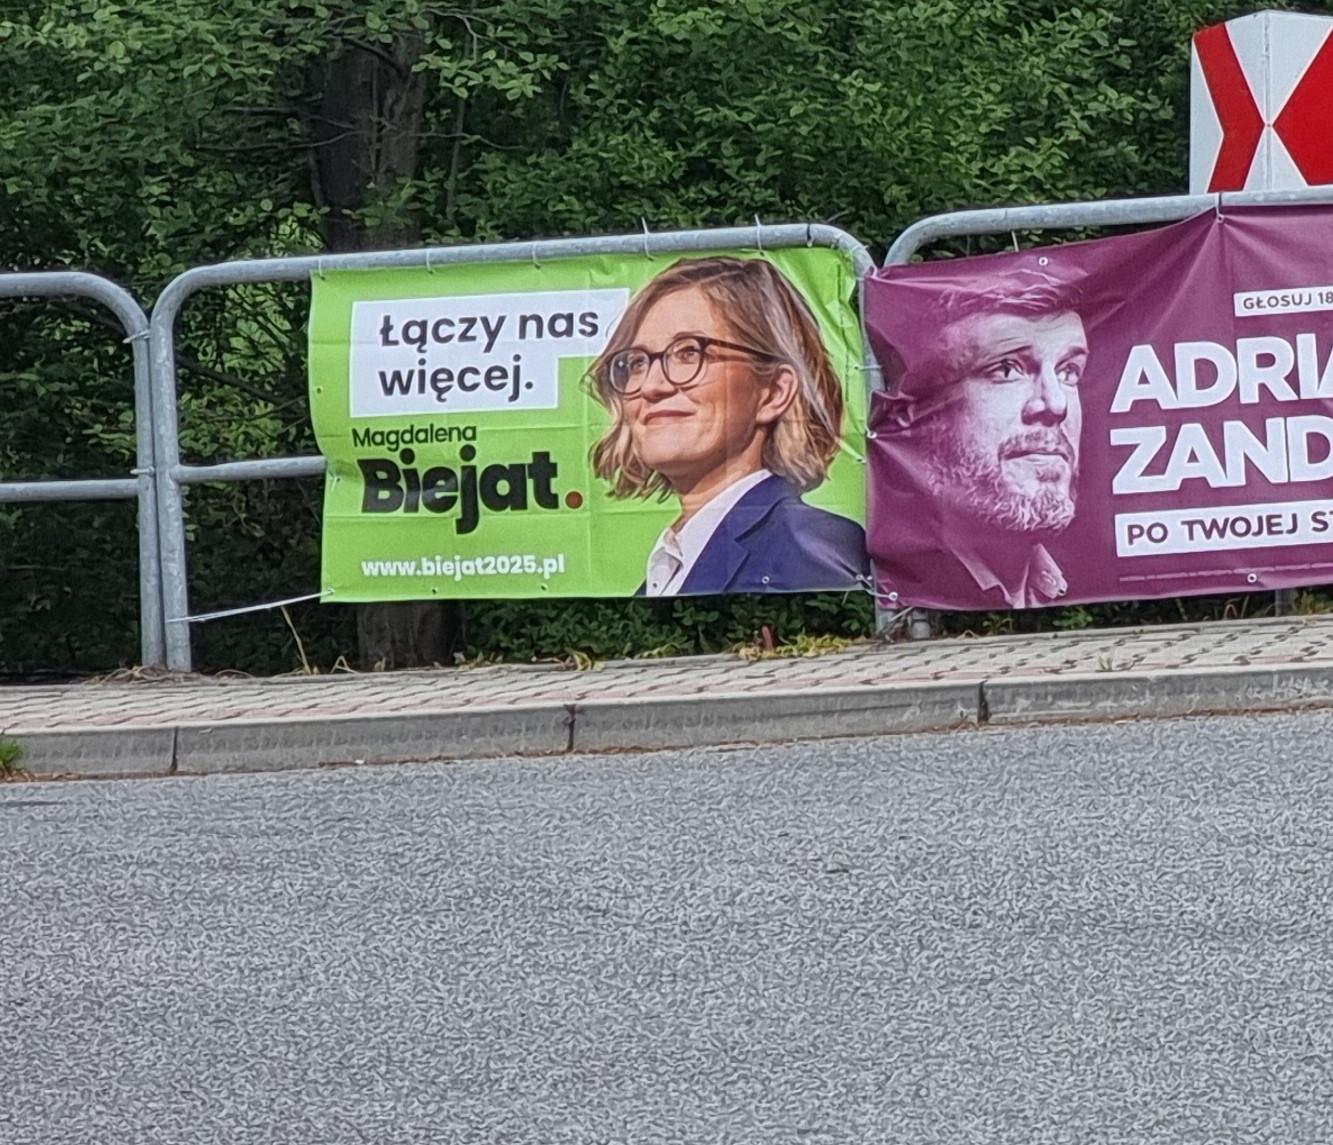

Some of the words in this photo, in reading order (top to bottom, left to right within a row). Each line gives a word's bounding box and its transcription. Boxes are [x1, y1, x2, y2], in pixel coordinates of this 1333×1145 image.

[1243, 293, 1312, 310] GŁOSUJ
[379, 314, 507, 353] Łączy
[518, 309, 599, 340] nas
[378, 354, 534, 403] więcej.
[351, 423, 477, 452] Magdalena
[357, 444, 584, 534] Biejat.
[1127, 522, 1168, 545] PO
[1181, 513, 1298, 541] TWOJEJ
[361, 553, 565, 580] www.biejat2025.pl
